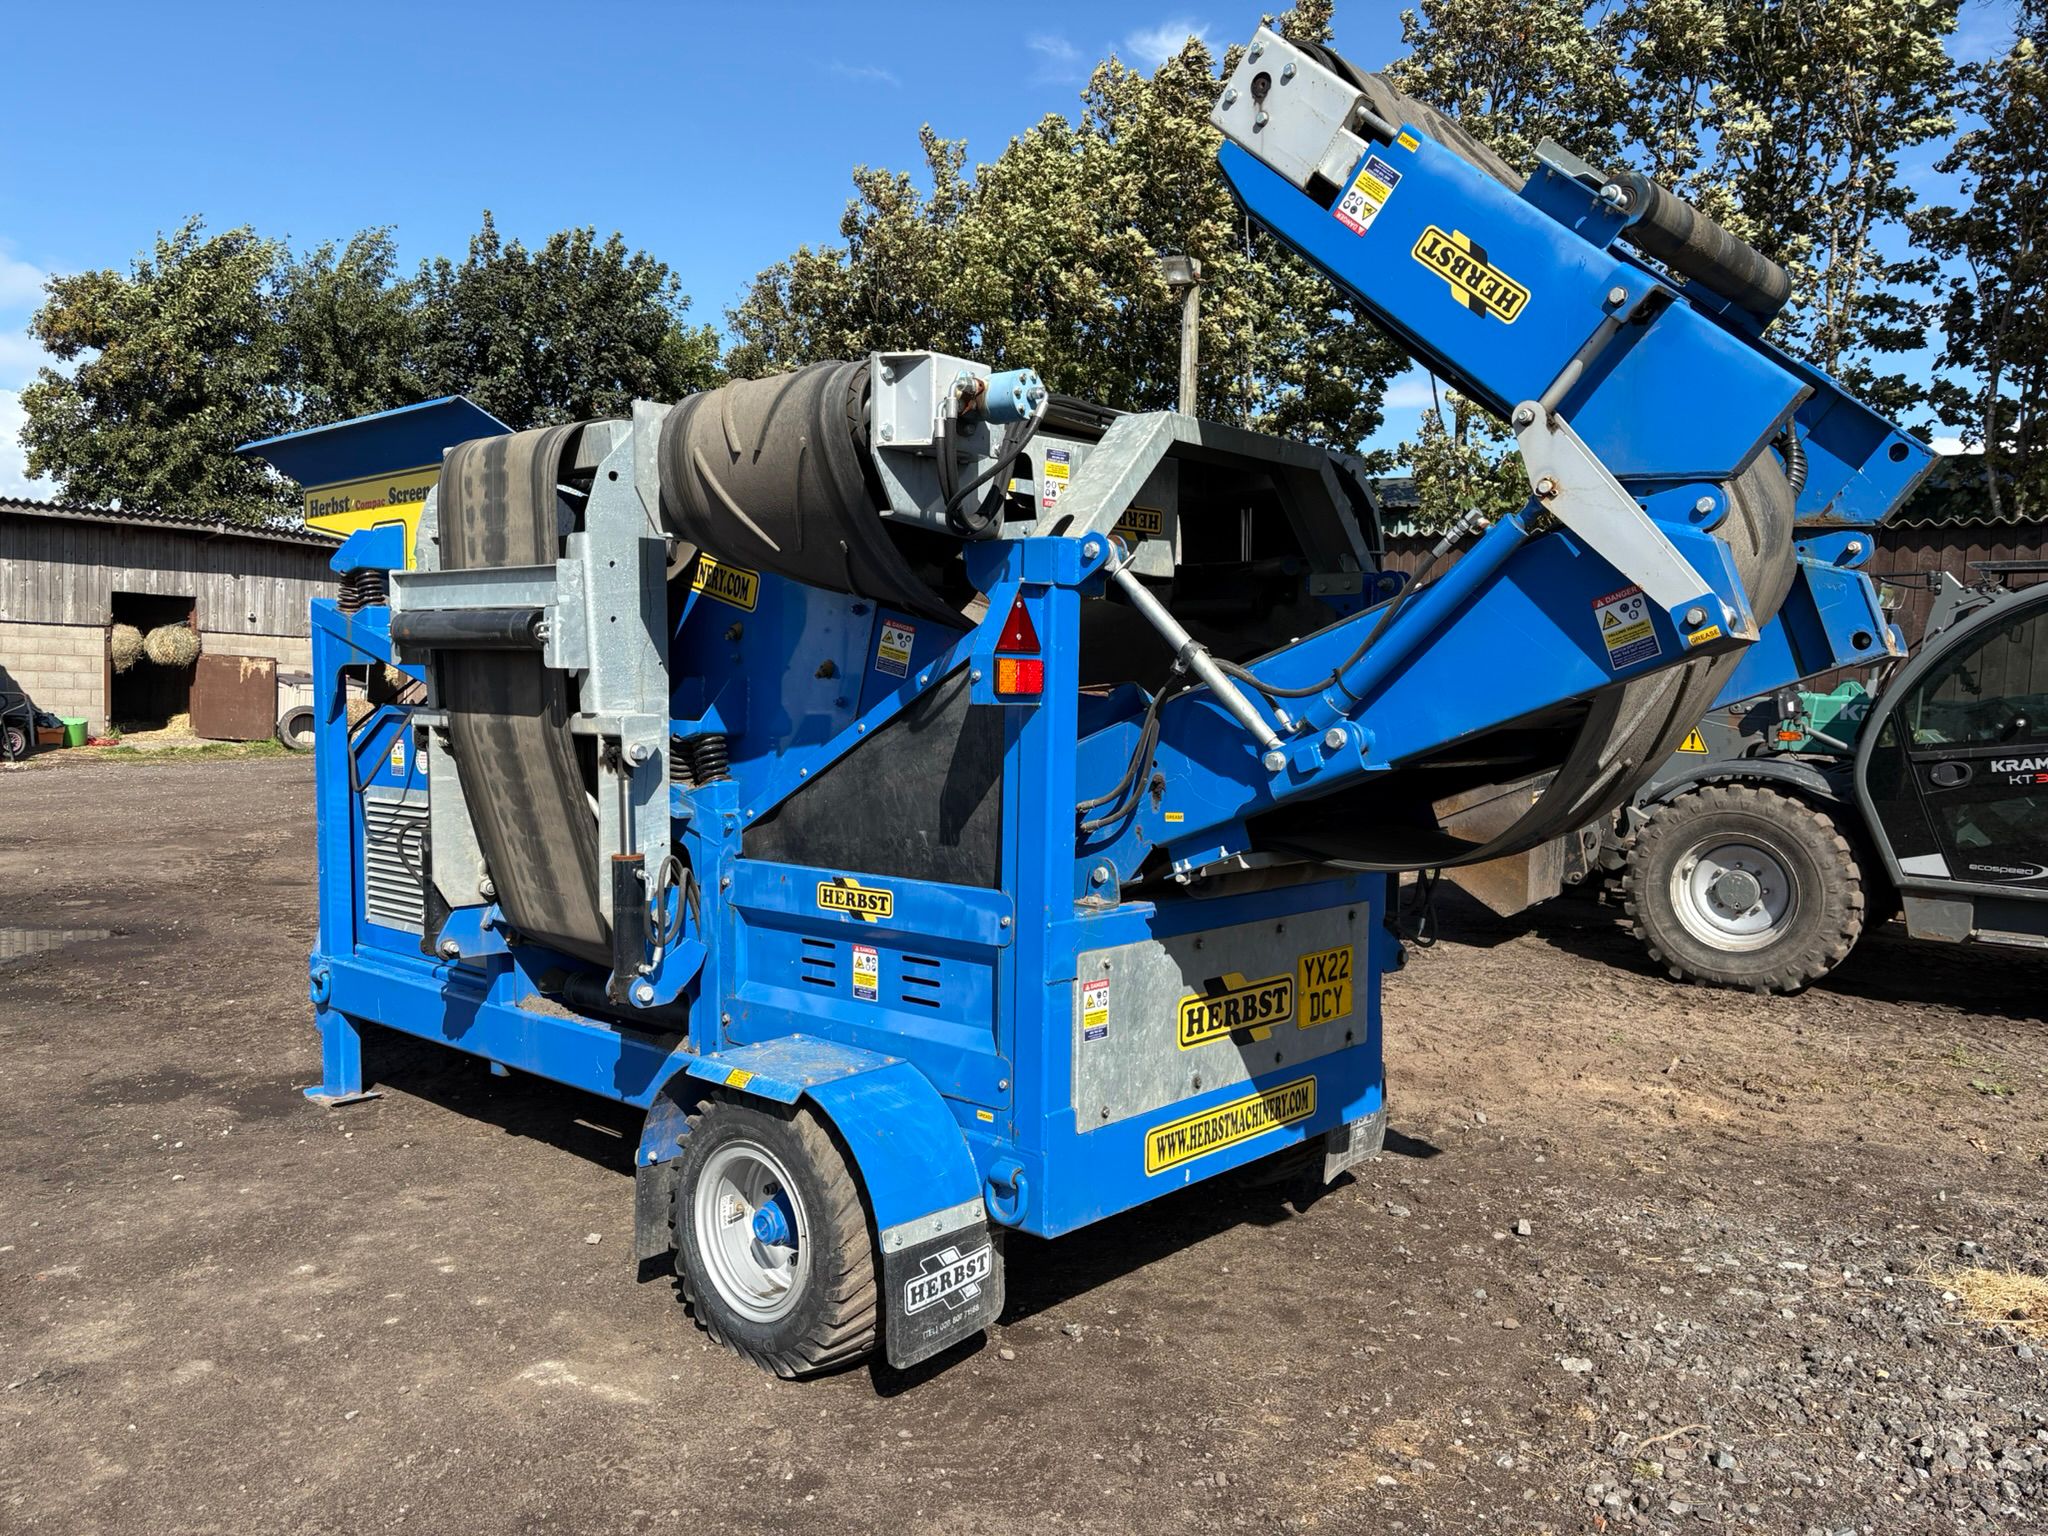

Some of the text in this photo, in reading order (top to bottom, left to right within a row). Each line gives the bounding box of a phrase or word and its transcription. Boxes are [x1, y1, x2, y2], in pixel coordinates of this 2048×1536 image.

[1336, 211, 1359, 231] DANGER
[1421, 237, 1521, 314] HERBST
[309, 495, 351, 518] Herbst
[355, 498, 386, 511] Compac
[1605, 586, 1638, 605] DANGER
[892, 621, 914, 632] DANGER
[1690, 628, 1720, 645] GREASE
[1968, 863, 2034, 876] ecospeed
[822, 888, 889, 912] HERBST
[1303, 949, 1350, 987] YX22
[1185, 985, 1289, 1038] HERBST
[1309, 985, 1344, 1023] DCY
[1156, 1085, 1310, 1163] WWW.HERBSTMACHINERY.COM
[910, 1252, 988, 1306] HERBST
